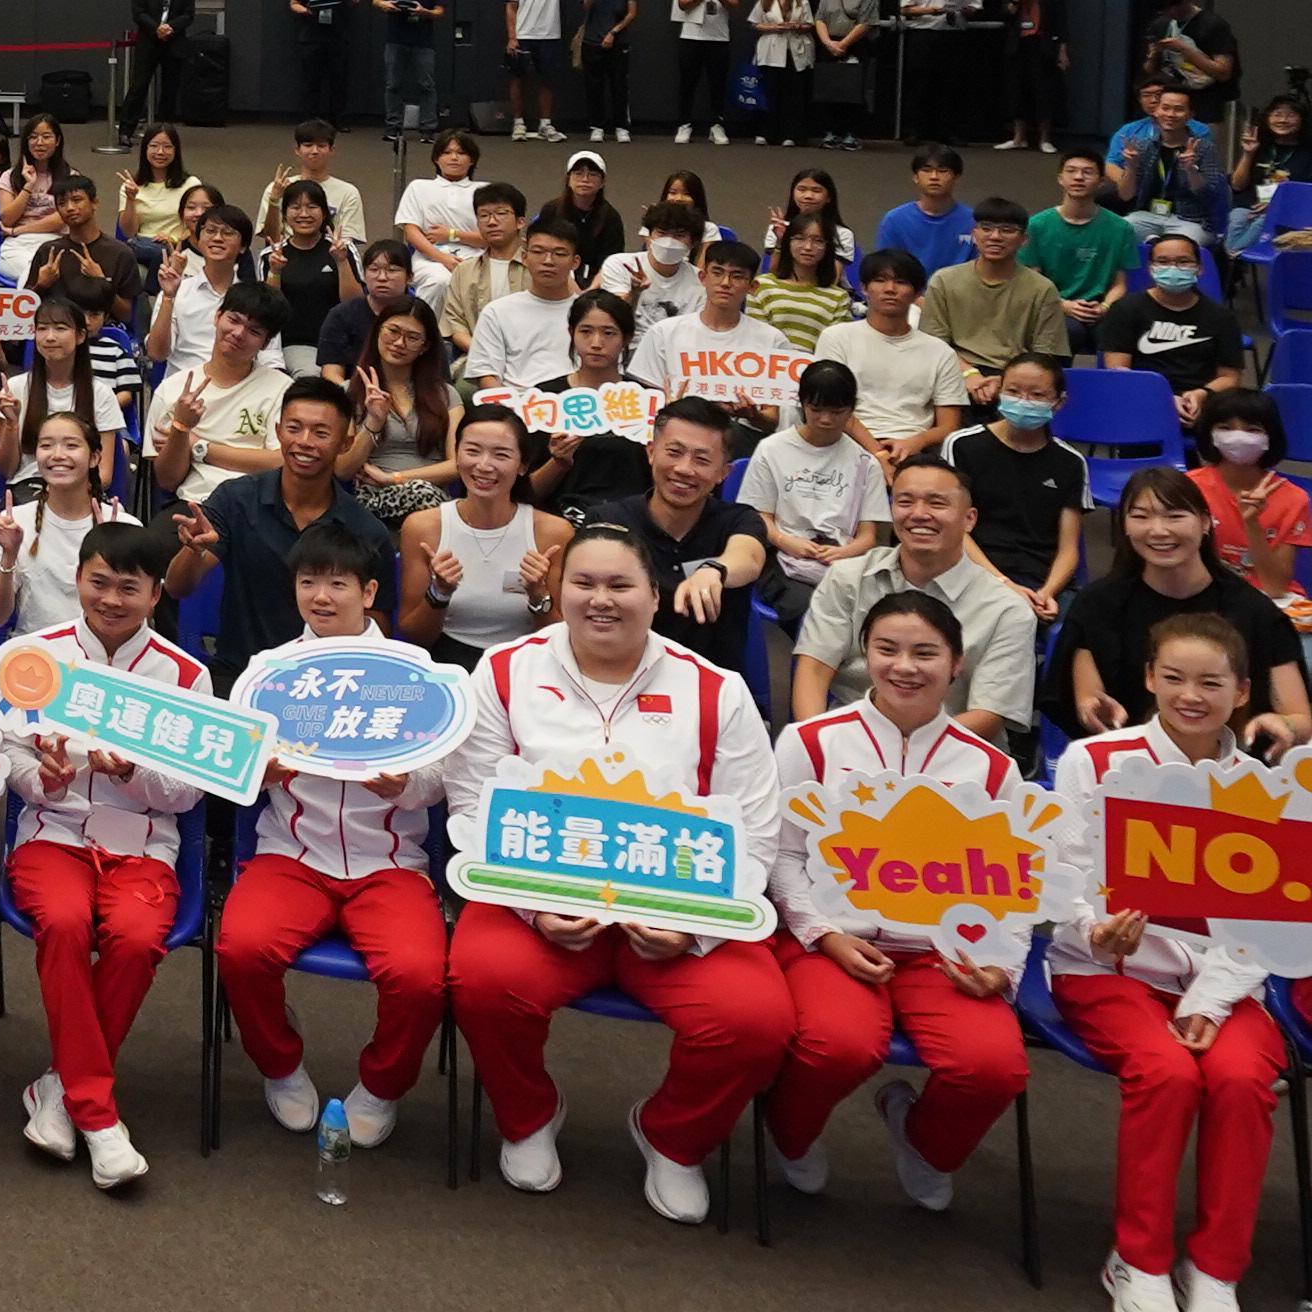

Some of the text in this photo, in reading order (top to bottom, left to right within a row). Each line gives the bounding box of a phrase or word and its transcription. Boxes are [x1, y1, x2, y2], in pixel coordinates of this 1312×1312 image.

[1149, 321, 1198, 340] NIKE
[289, 667, 425, 701] 永不 NEVER
[65, 683, 235, 769] 奧運健兒
[283, 705, 407, 739] GIVE 放棄
[296, 722, 324, 738] UP
[500, 808, 727, 884] 能量滿格
[1125, 818, 1312, 902] NO.
[833, 846, 1034, 900] Yeah!
